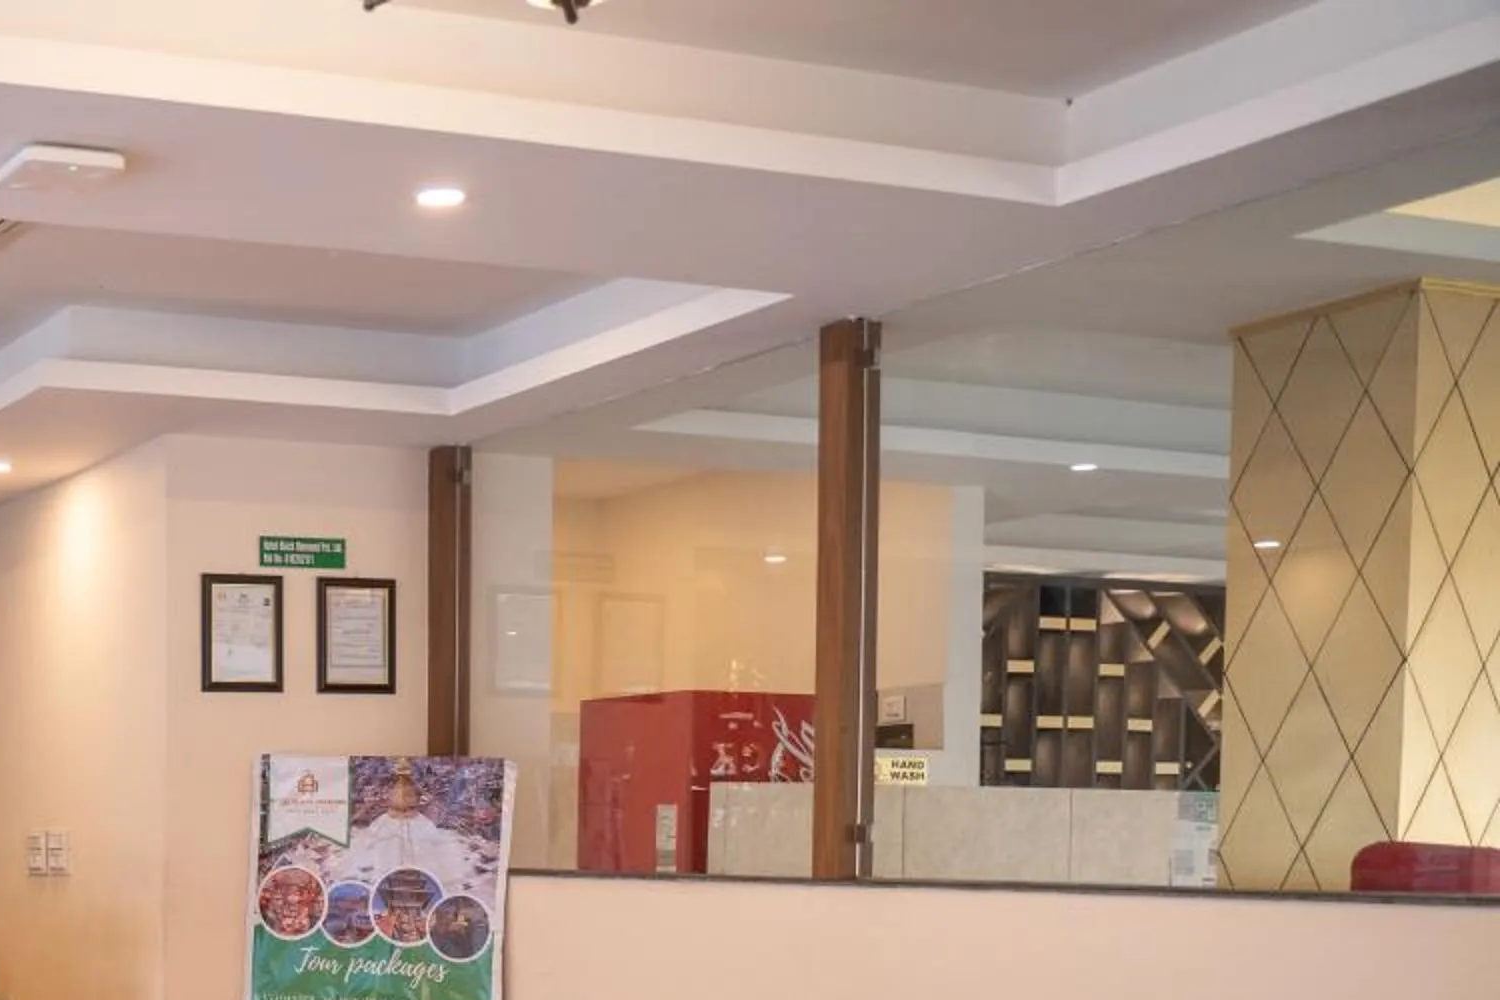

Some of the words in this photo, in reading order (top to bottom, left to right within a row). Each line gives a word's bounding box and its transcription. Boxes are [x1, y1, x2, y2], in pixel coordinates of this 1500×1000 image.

[891, 759, 925, 769] HAND
[890, 771, 925, 781] WASH
[293, 945, 342, 975] Tour
[343, 948, 449, 989] packages
